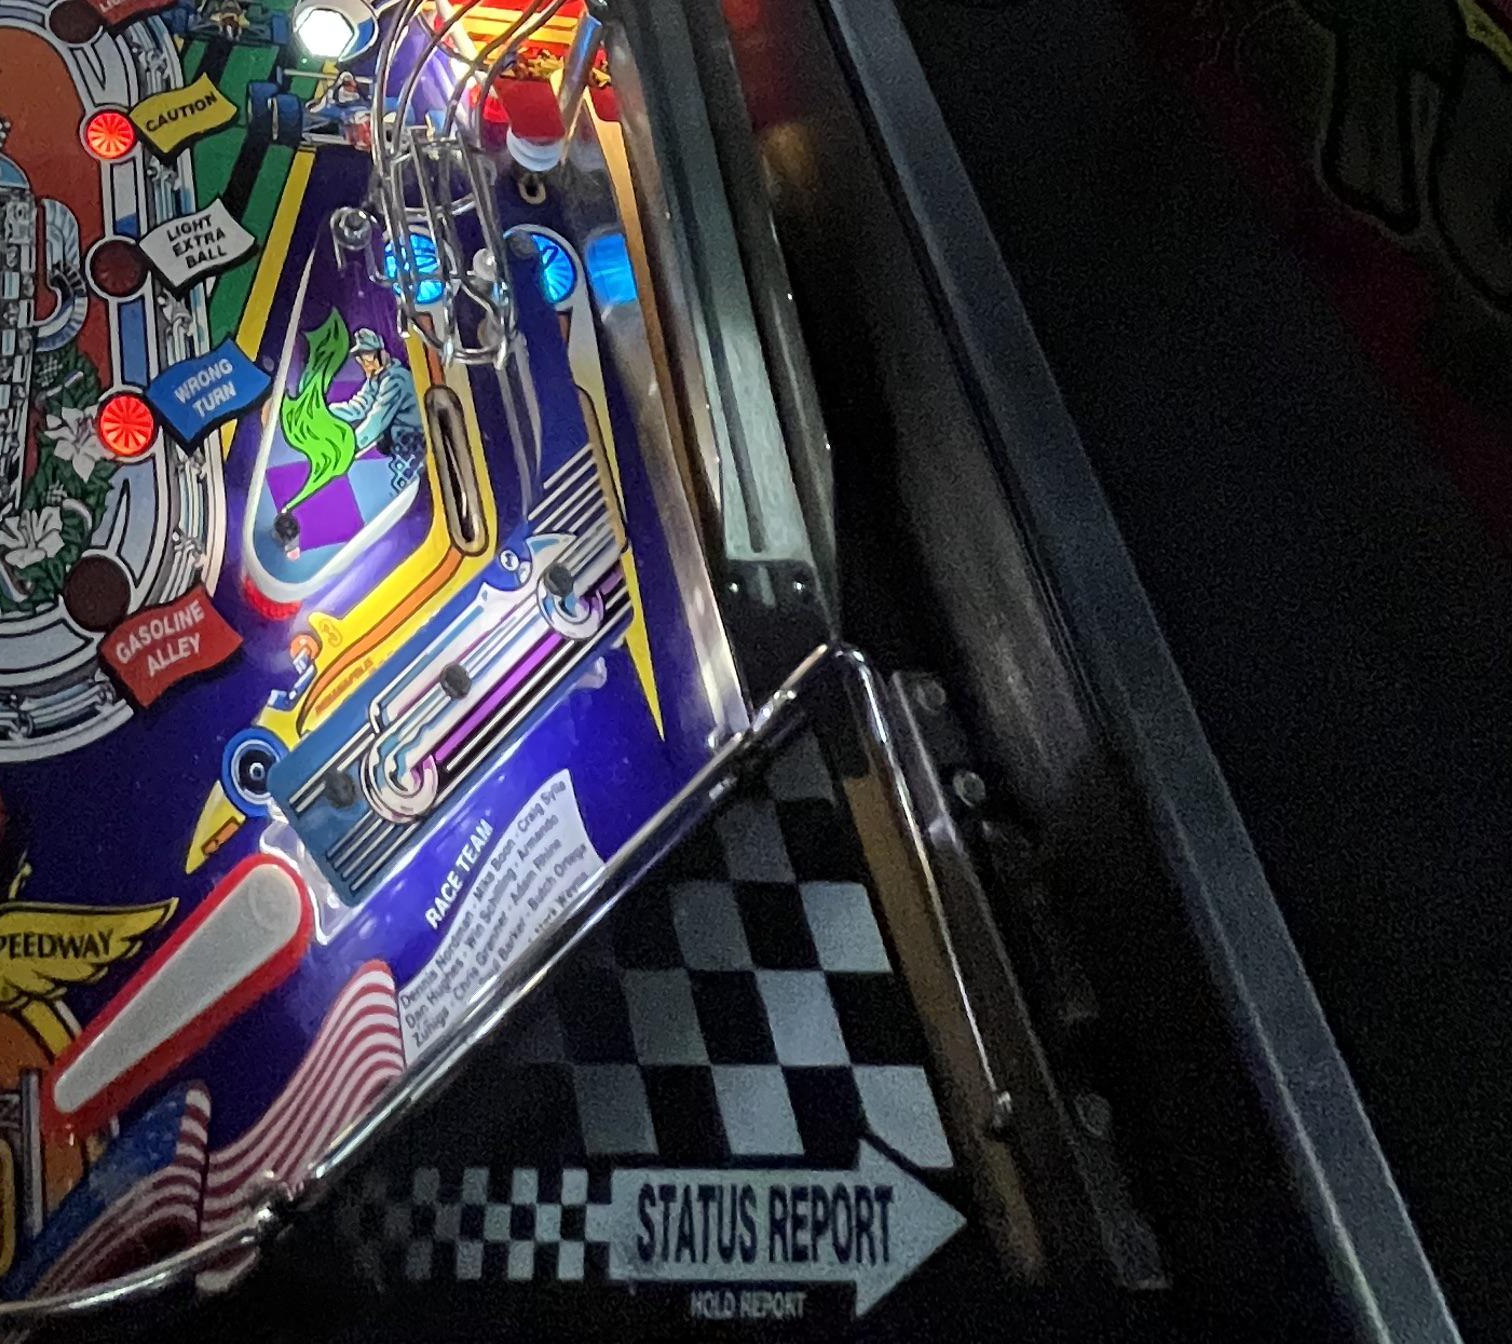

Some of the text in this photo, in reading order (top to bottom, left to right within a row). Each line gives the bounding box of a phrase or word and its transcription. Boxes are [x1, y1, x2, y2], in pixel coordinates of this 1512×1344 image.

[145, 90, 218, 134] CAUTION
[165, 212, 215, 243] LIGHT
[173, 227, 227, 259] EXTRA
[184, 244, 229, 272] BALL
[174, 357, 235, 406] WRONG
[193, 383, 238, 419] TURN
[115, 603, 206, 665] GASOLINE
[146, 633, 203, 677] ALLEY
[423, 817, 494, 931] RACE TEAM
[636, 1183, 893, 1265] STATUS REPORT
[689, 1292, 809, 1320] HOLD REPORT
